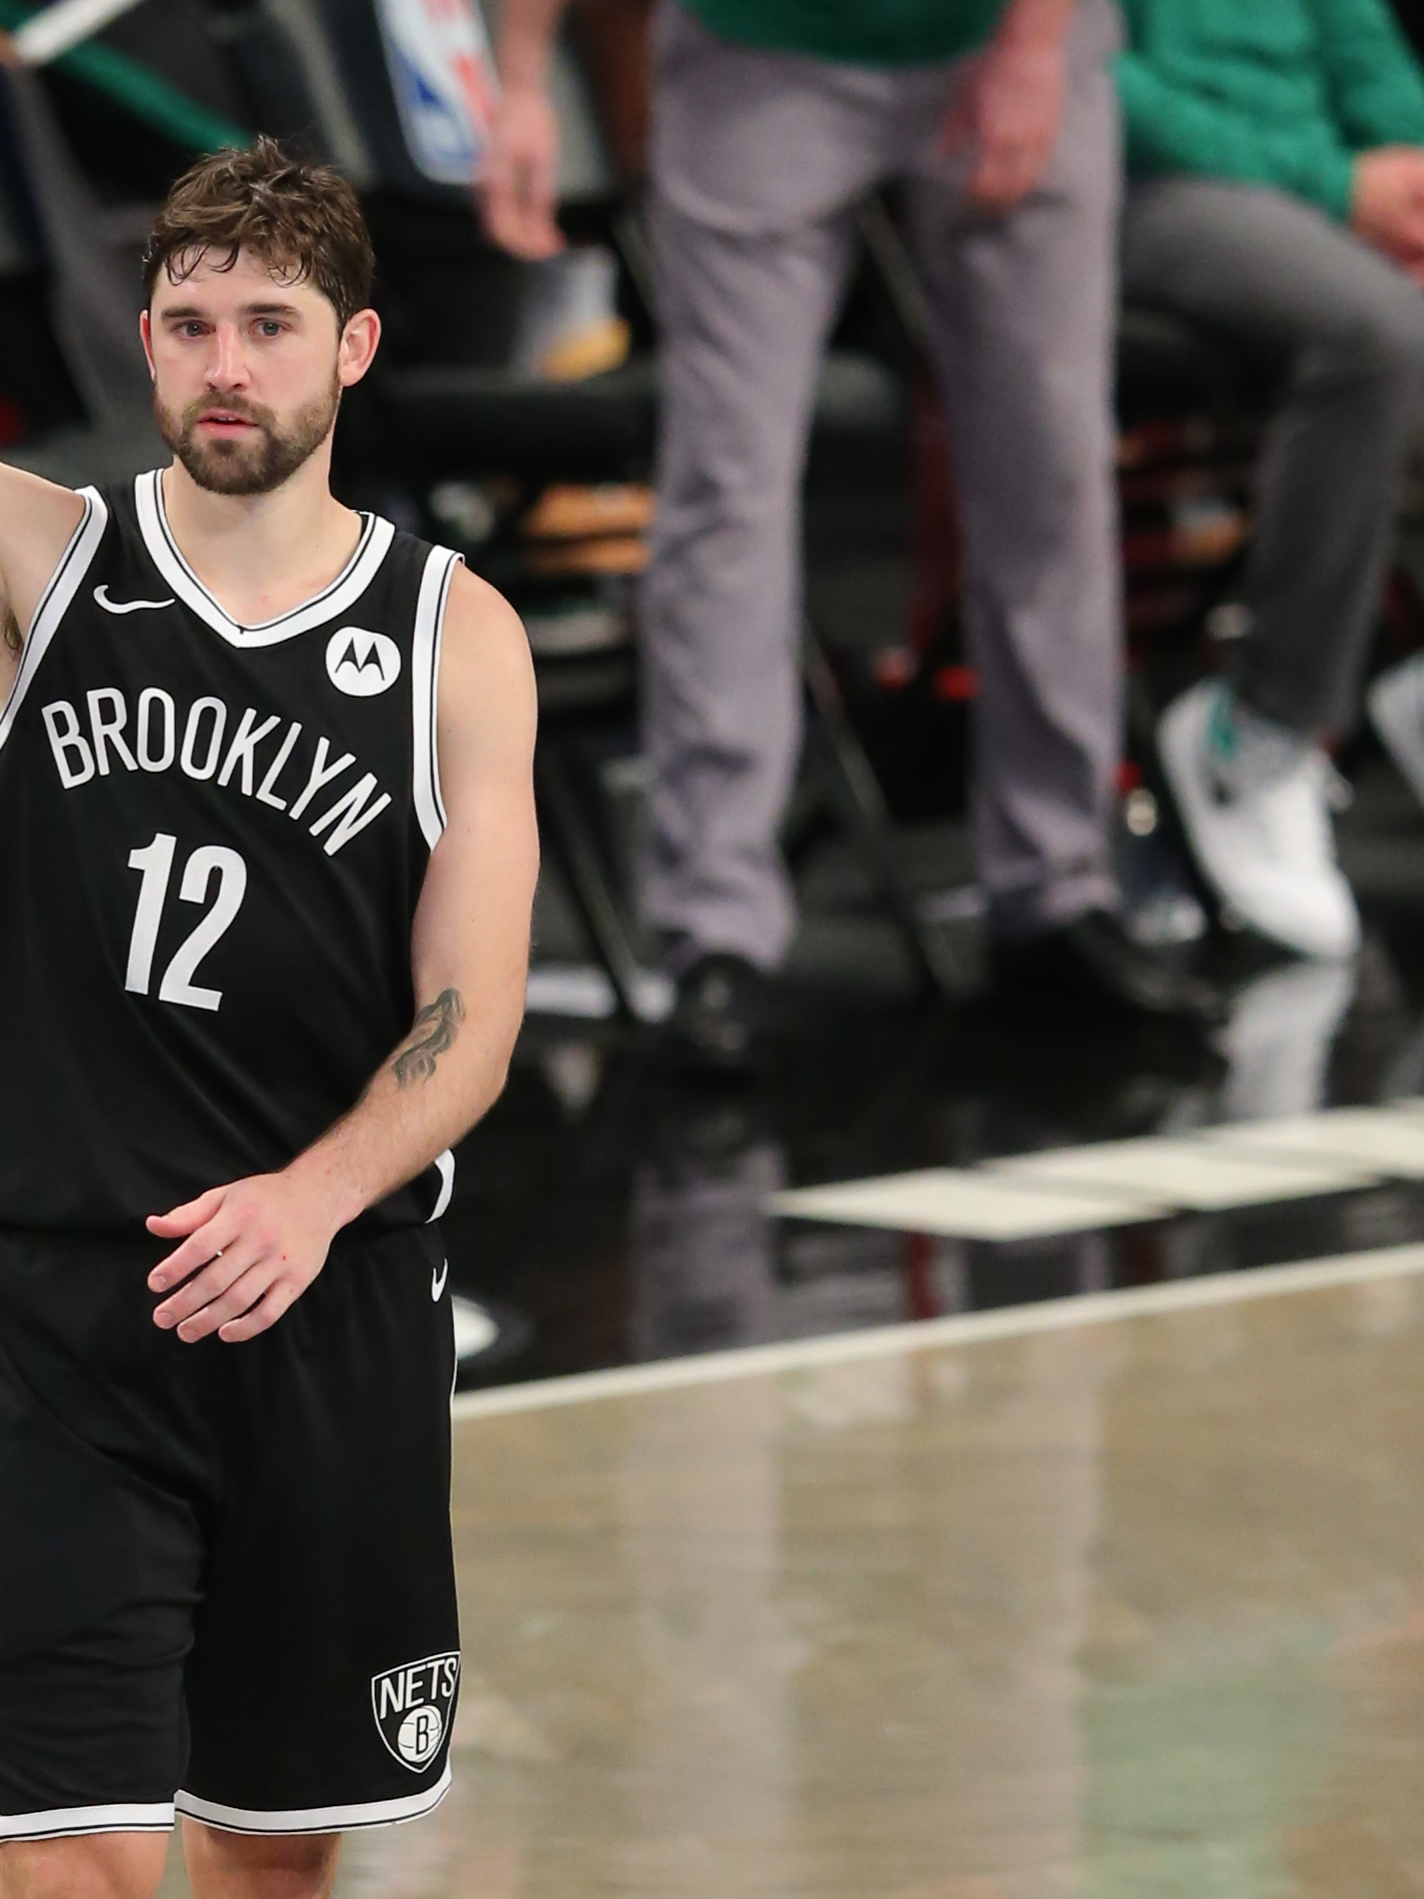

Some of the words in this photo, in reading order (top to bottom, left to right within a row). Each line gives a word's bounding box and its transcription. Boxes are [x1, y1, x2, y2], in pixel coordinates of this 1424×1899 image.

[41, 687, 392, 856] BROOKLYN
[124, 832, 247, 1012] 12
[379, 1656, 458, 1720] NETS
